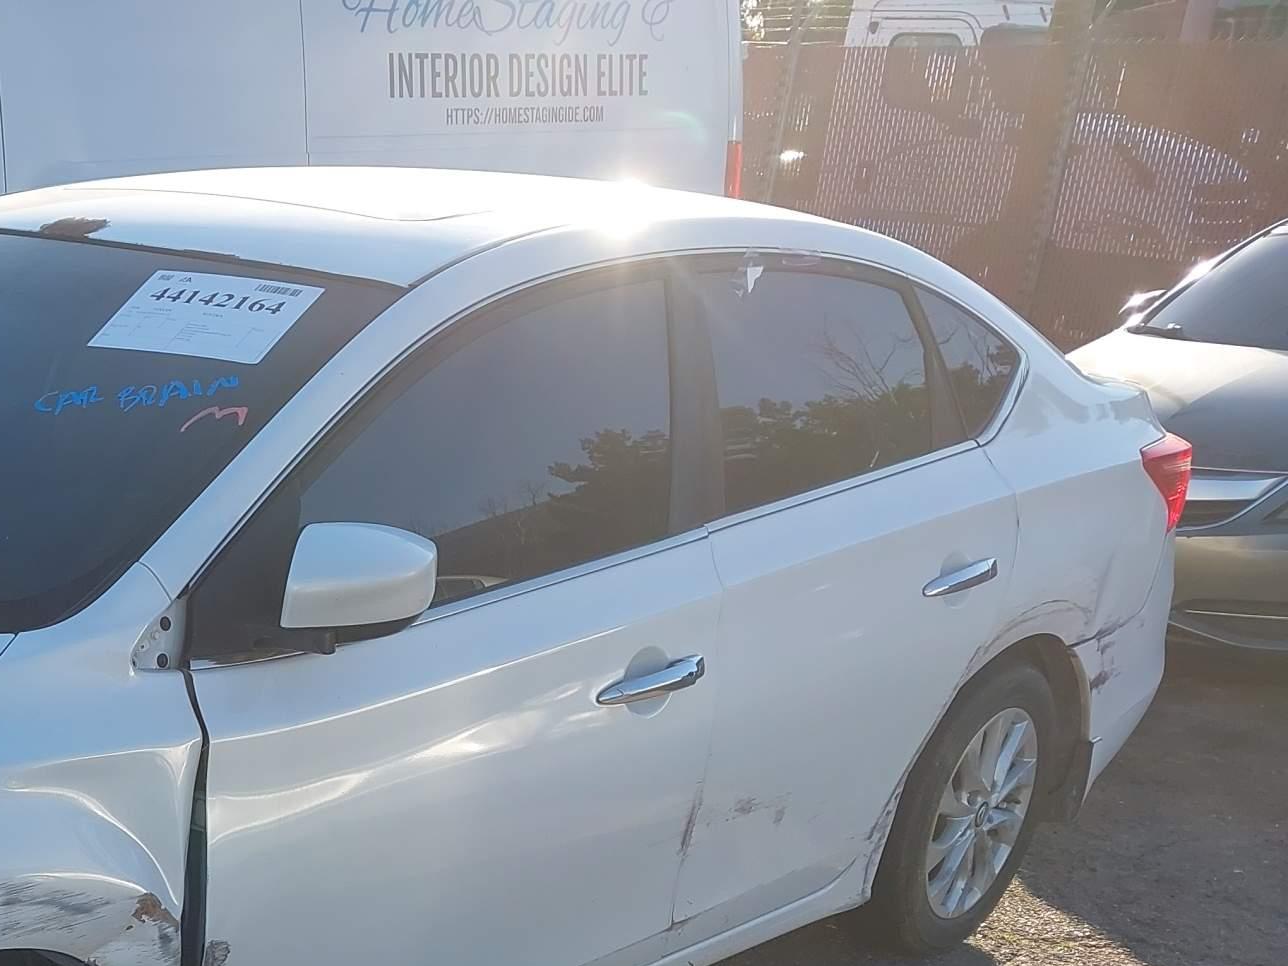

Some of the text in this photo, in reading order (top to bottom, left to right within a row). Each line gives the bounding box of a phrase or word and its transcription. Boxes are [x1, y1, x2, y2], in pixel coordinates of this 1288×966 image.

[388, 52, 649, 98] INTERIOR DESIGN ELITE
[446, 105, 604, 126] HTTPS://HOMESTAGINGIDE.COM
[150, 287, 287, 316] 44142164
[34, 386, 104, 416] CAR
